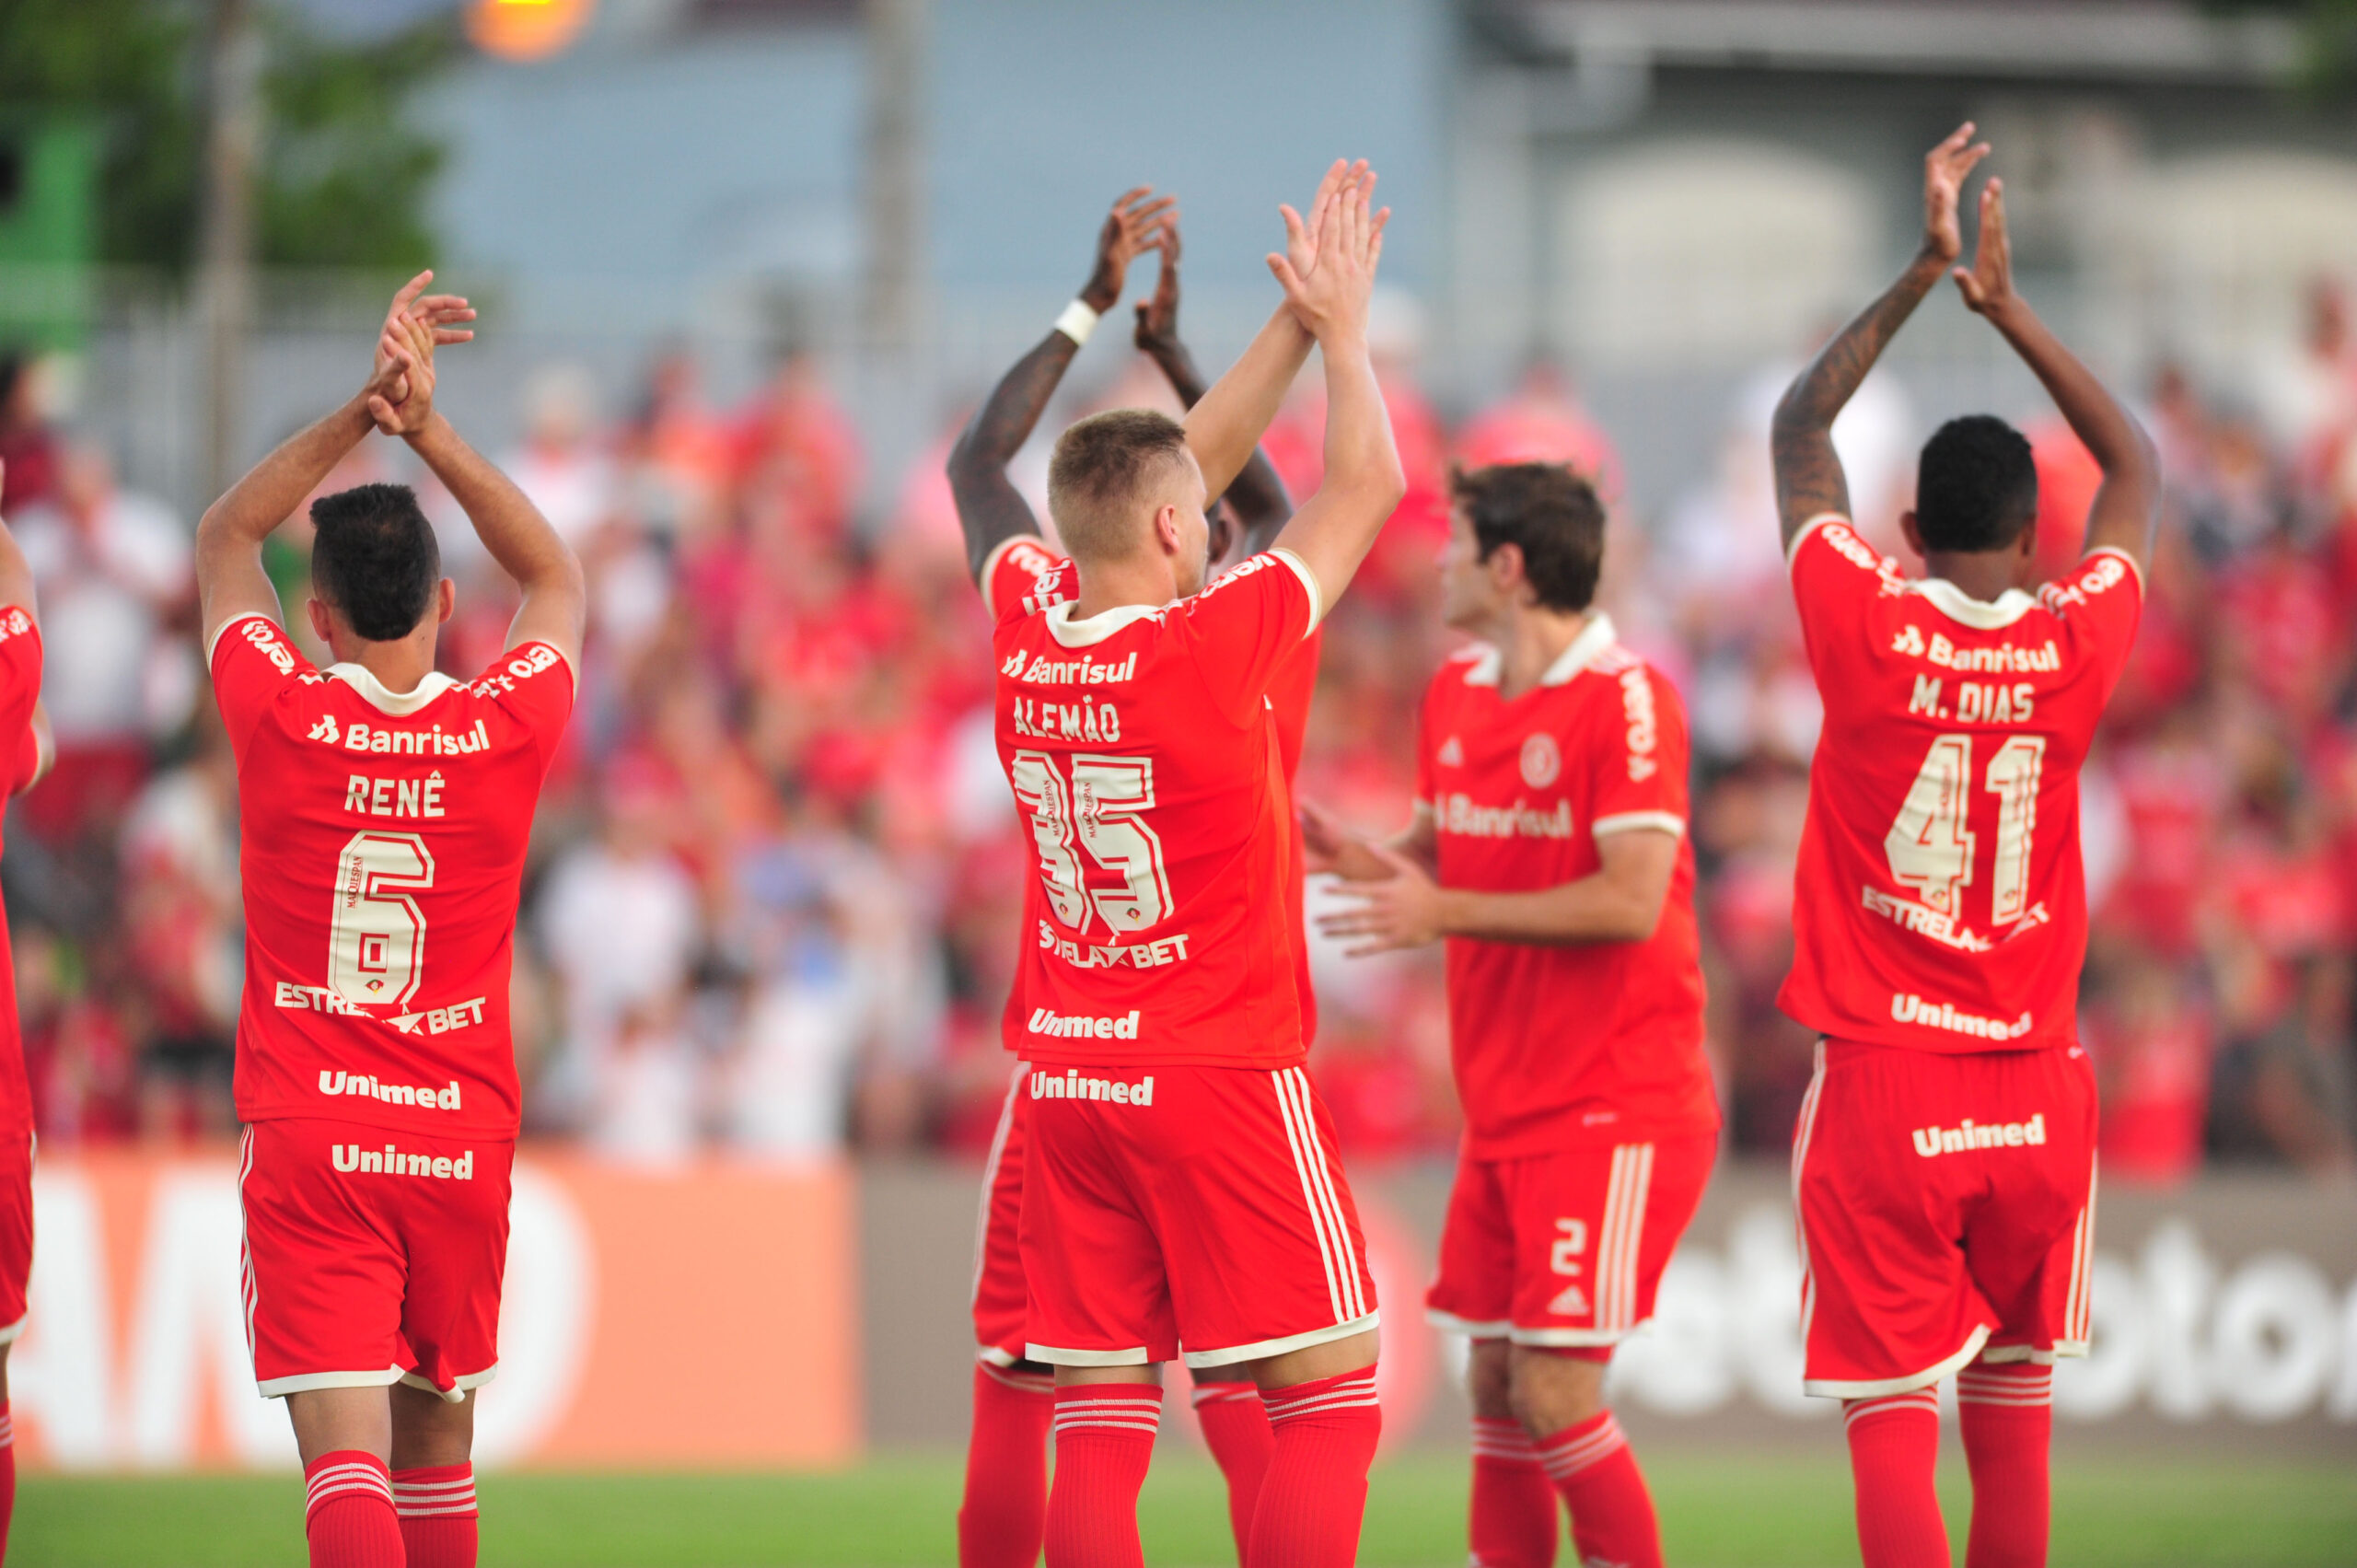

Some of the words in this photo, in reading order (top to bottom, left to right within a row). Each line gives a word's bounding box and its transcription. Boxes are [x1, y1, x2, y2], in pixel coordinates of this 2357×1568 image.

[1022, 652, 1137, 685] Banrisul
[1927, 633, 2061, 673] Banrisul
[1013, 695, 1121, 743] ALEMÃO
[1908, 674, 1948, 720] M.
[1956, 681, 2036, 723] DIAS
[345, 719, 490, 755] Banrisul
[344, 770, 446, 818] RENÊ
[1448, 792, 1573, 838] Banrisul
[1012, 749, 1175, 937] 35
[1884, 734, 2046, 926] 41
[328, 830, 435, 1005] 6
[1891, 993, 2033, 1040] Unimed
[319, 1070, 461, 1110] Unimed
[1030, 1069, 1155, 1107] Unimed
[1912, 1113, 2047, 1157] Unimed
[331, 1144, 473, 1180] Unimed
[1550, 1217, 1587, 1276] 2
